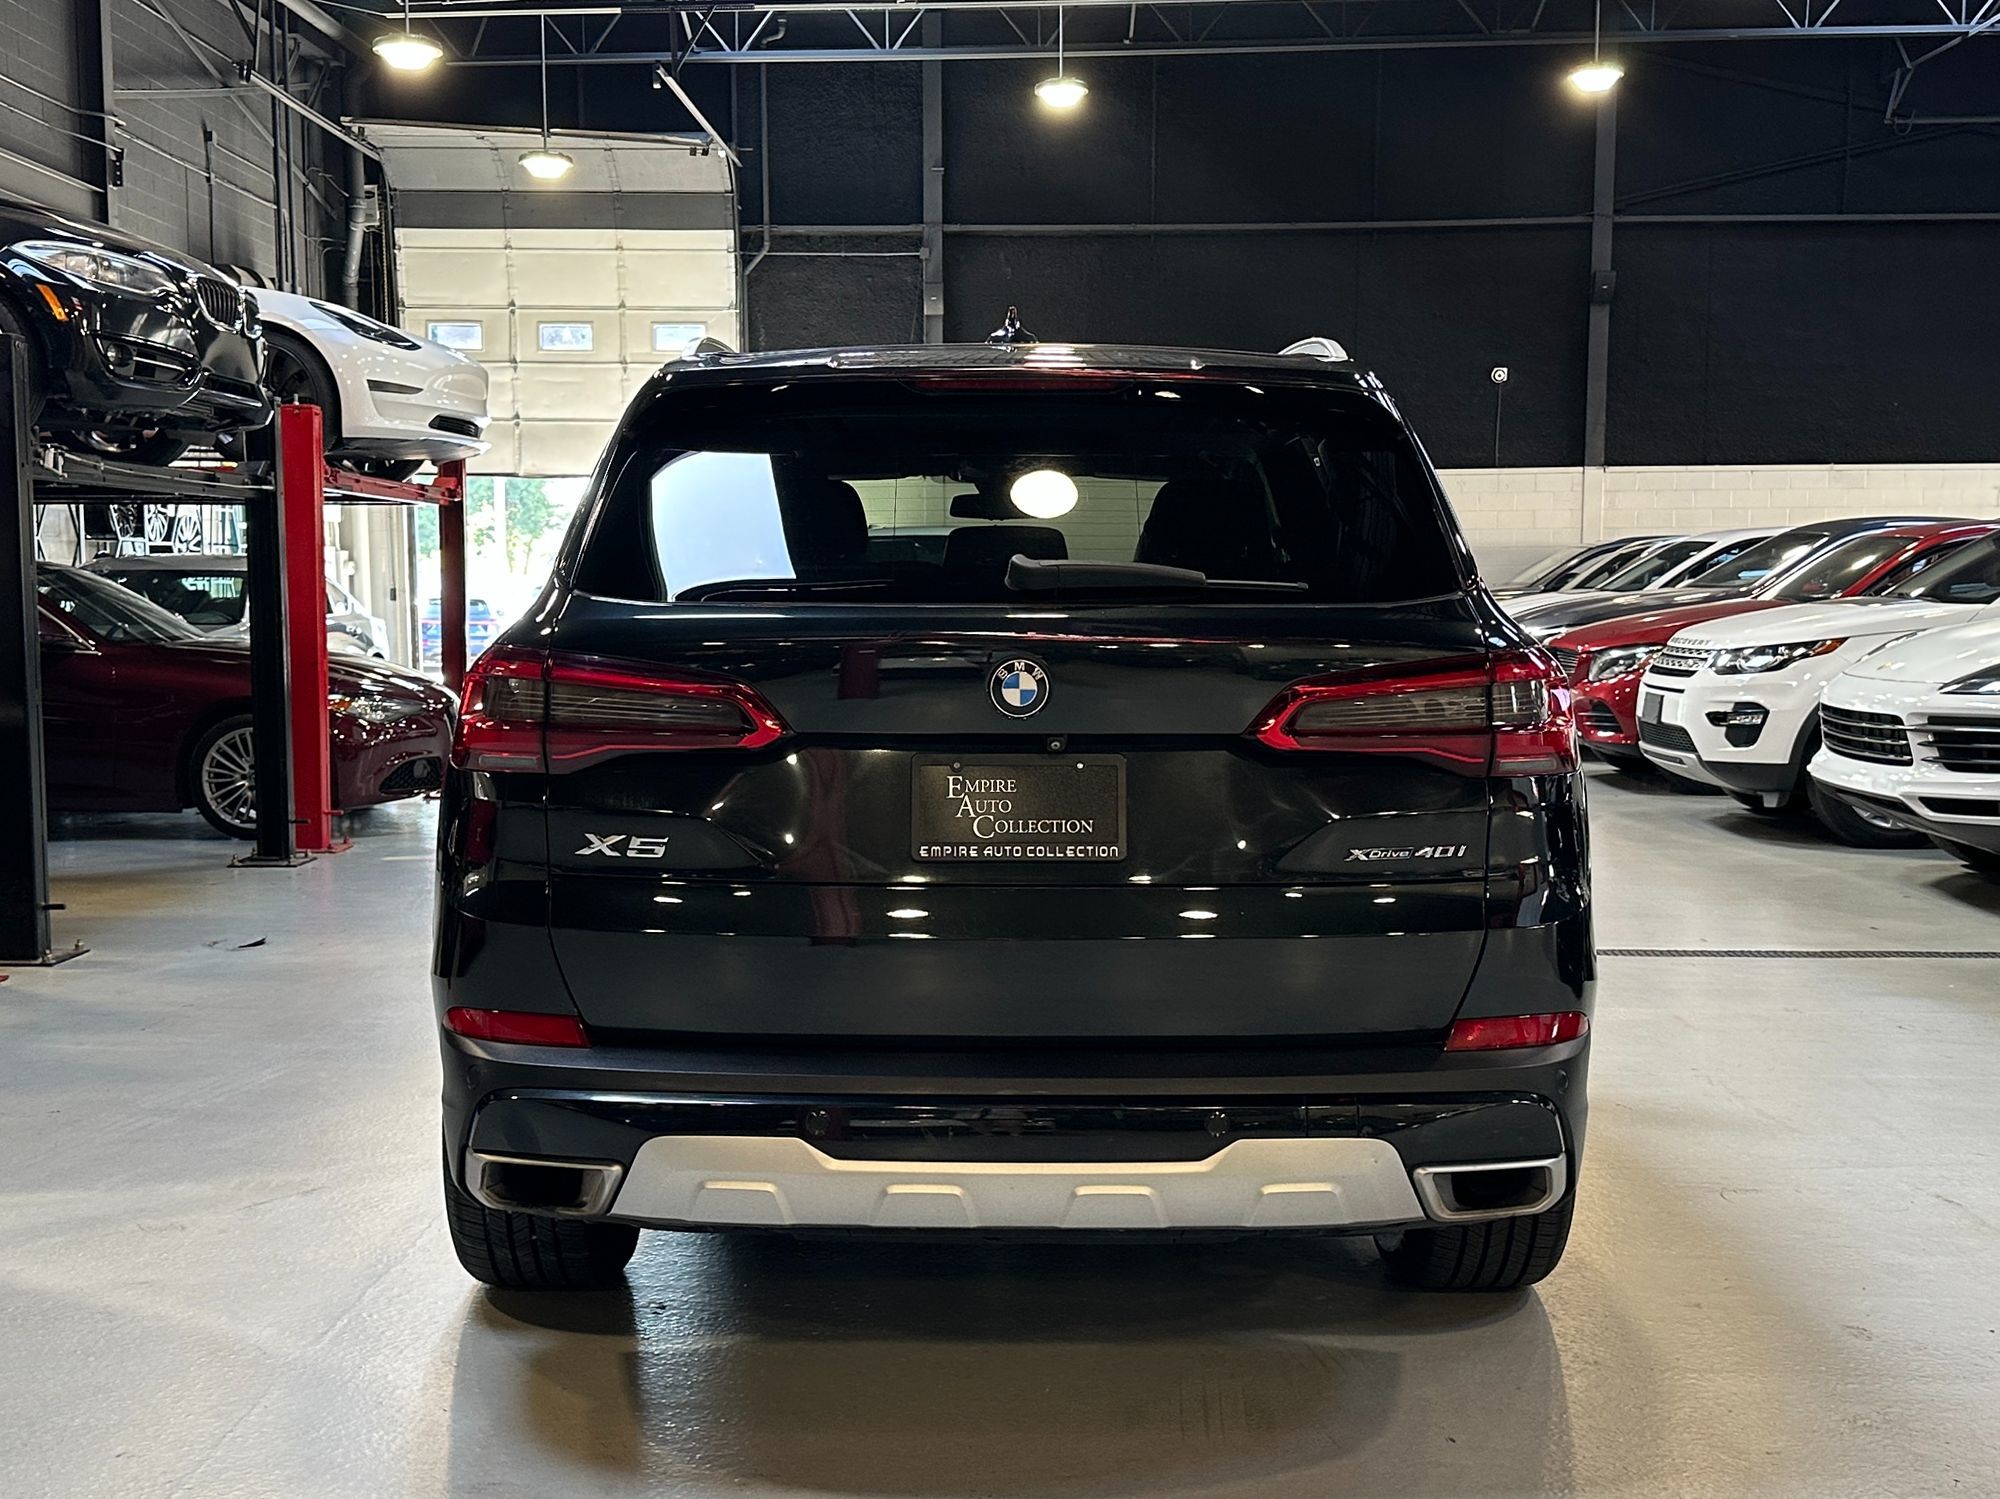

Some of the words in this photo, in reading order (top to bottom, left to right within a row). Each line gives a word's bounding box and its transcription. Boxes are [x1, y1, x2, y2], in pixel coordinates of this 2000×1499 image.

[997, 661, 1044, 680] BMW
[946, 775, 1017, 799] EMPIRE
[955, 794, 1012, 818] AUTO
[972, 815, 1094, 839] COLLECTION
[574, 833, 669, 858] X5
[919, 846, 979, 857] EMPIRE
[983, 846, 1022, 857] AUTO
[1026, 846, 1119, 857] COLLECTION
